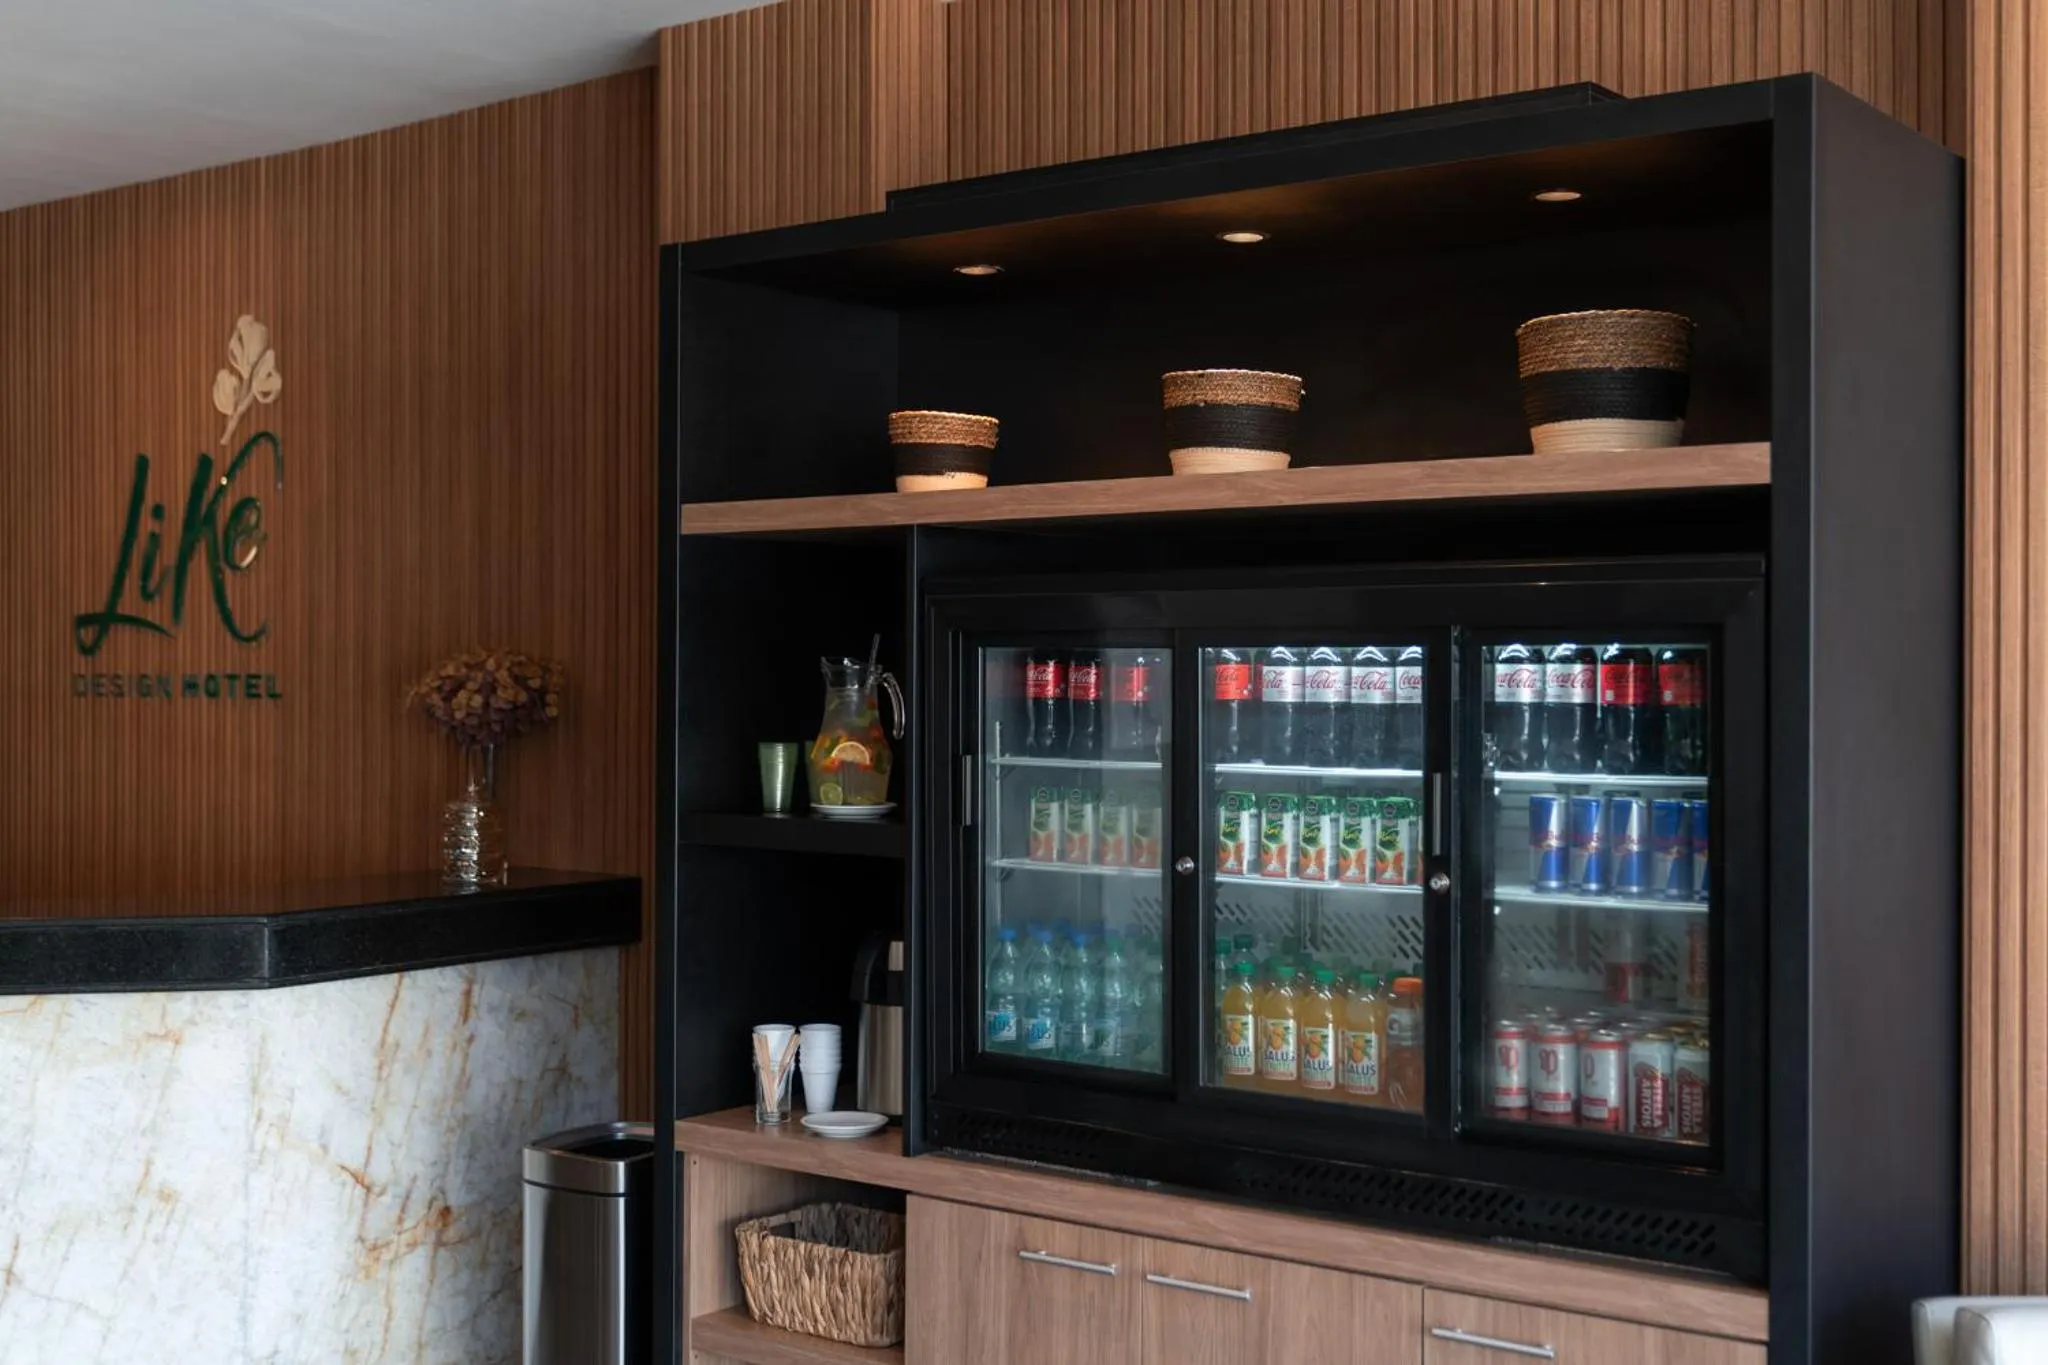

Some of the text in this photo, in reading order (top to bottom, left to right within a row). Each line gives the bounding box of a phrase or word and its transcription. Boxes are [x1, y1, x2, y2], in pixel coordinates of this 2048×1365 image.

[73, 673, 283, 699] DESIGN HOTEL
[1641, 1078, 1652, 1128] ARTOIS
